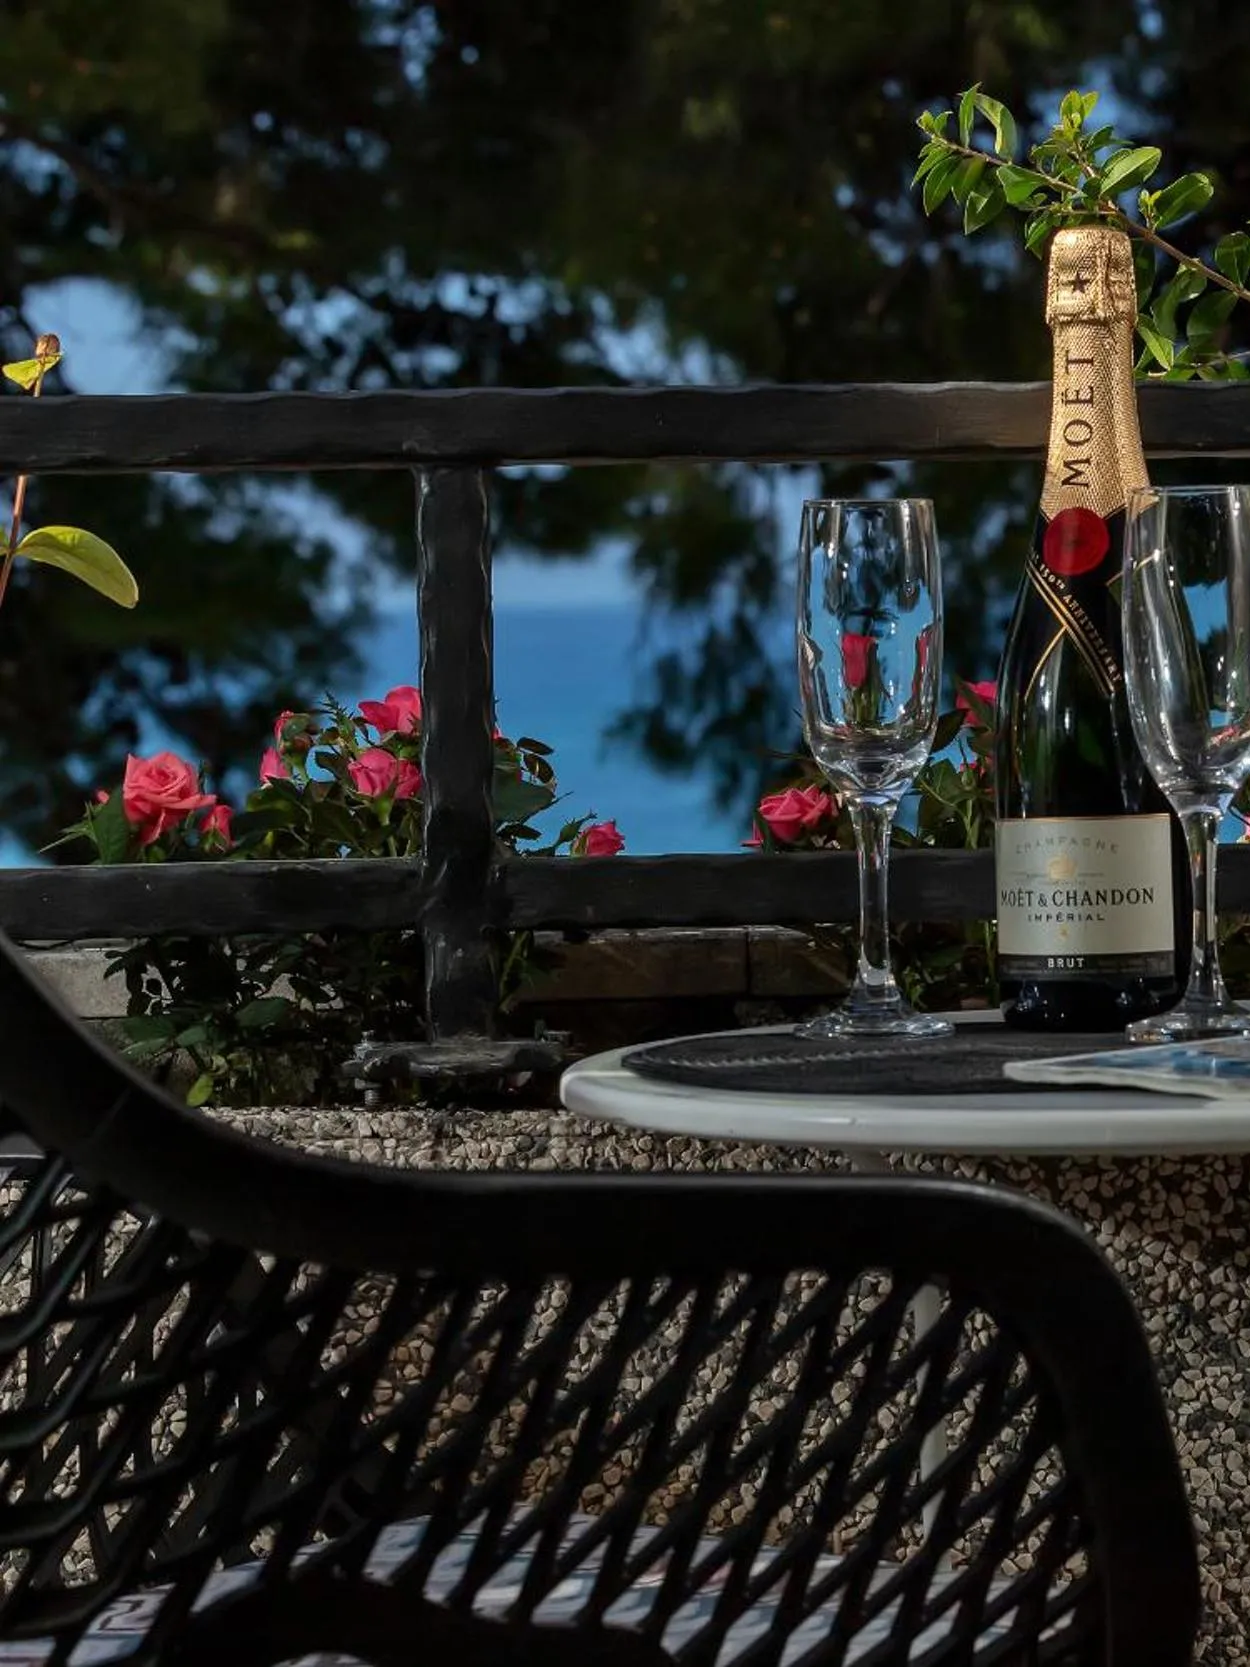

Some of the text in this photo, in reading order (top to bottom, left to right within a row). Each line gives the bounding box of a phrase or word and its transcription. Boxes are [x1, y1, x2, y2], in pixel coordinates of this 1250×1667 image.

[1062, 350, 1096, 487] MOËT
[1016, 836, 1120, 854] CHAMPAGNE
[1038, 894, 1049, 907] &
[1052, 887, 1155, 907] CHANDON
[1029, 911, 1105, 922] IMPÉRIAL
[1047, 958, 1085, 968] BRUT
